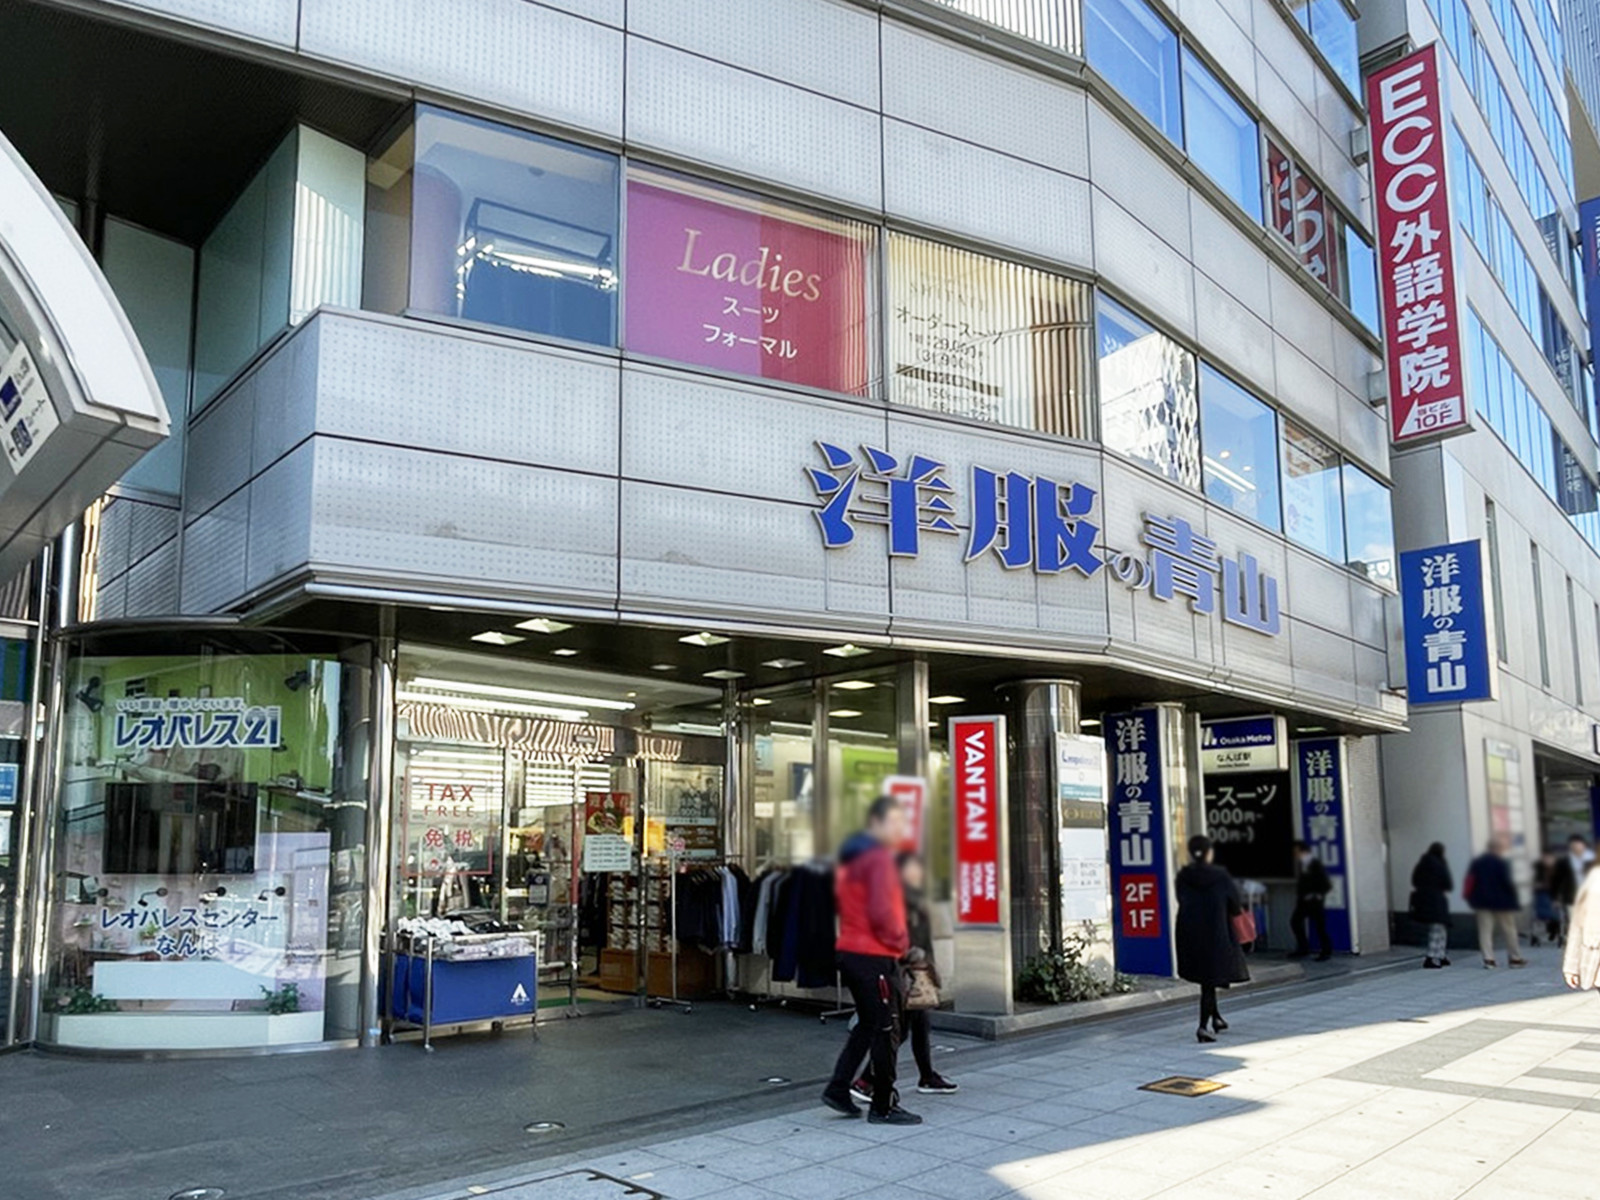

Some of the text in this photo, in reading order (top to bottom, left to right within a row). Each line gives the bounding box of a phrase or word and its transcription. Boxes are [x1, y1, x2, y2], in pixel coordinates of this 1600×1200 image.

[1379, 61, 1451, 397] ECC外語学院
[677, 228, 821, 301] Ladies
[722, 296, 779, 323] スーツ
[896, 305, 1003, 345] オーダースーツ
[703, 323, 797, 359] フォーマル
[1415, 409, 1452, 429] 10F
[805, 440, 1280, 637] 洋服の青山
[1421, 552, 1467, 694] 洋服の青山
[116, 706, 280, 747] レオパレス21
[424, 783, 474, 802] TAX
[964, 729, 988, 841] VANTAN
[1115, 717, 1154, 867] 洋服の青山
[424, 805, 474, 818] FREE
[1305, 750, 1339, 867] 洋服の青山
[1125, 883, 1153, 902] 2F
[1129, 909, 1155, 928] 1F
